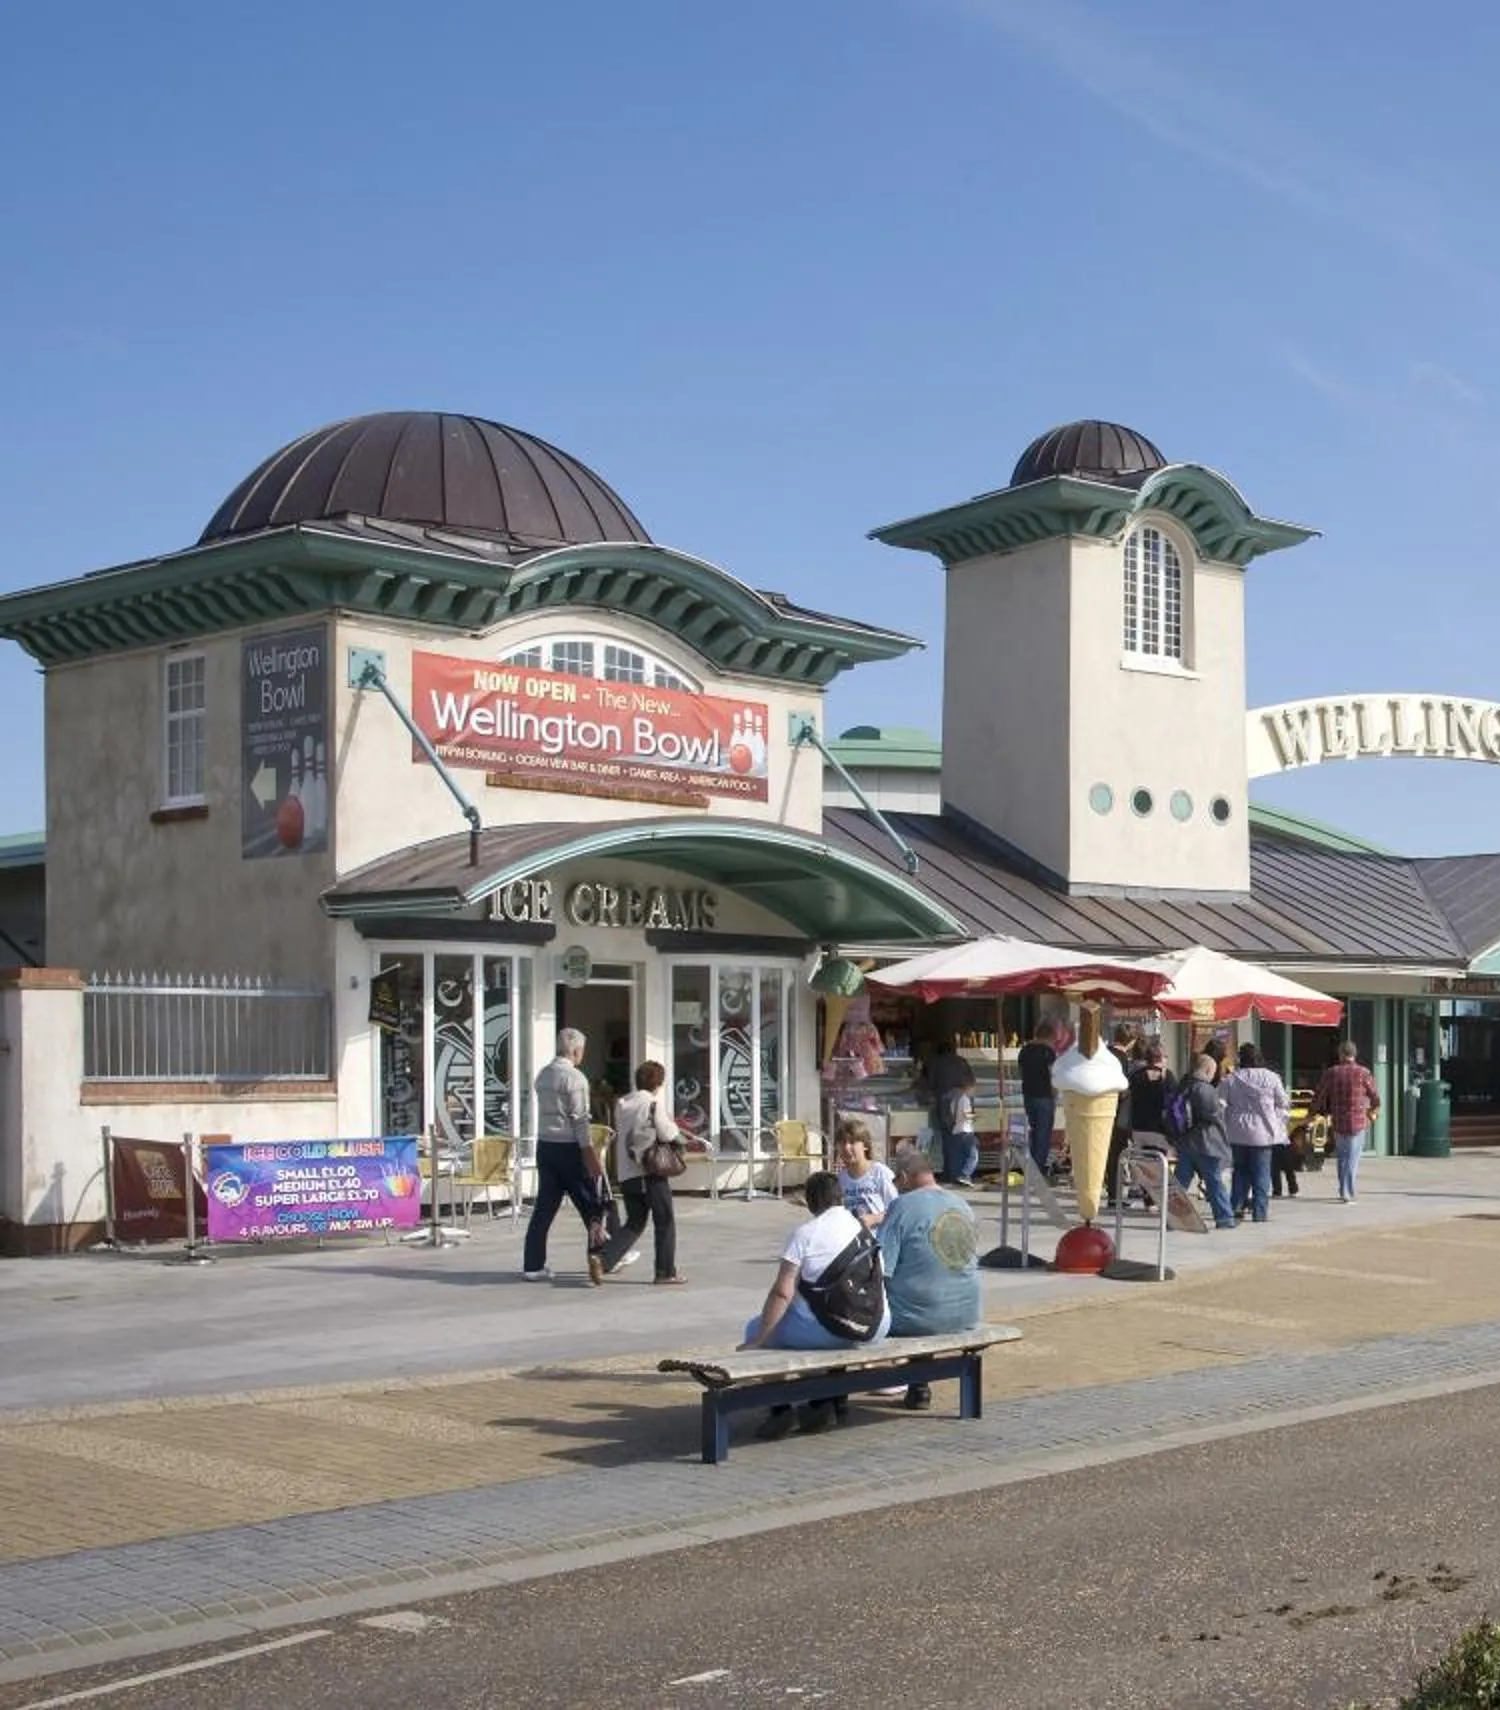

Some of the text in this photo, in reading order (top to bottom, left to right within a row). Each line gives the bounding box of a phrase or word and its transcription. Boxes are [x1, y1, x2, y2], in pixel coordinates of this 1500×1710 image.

[248, 646, 319, 679] Wellington
[261, 673, 305, 713] Bowl
[473, 670, 521, 694] NOW
[525, 677, 577, 703] OPEN
[596, 687, 627, 709] The
[430, 689, 720, 766] Wellington Bowl
[515, 754, 548, 768] OCEAN
[660, 771, 681, 783] AREA
[489, 879, 719, 931] ICE CREAMS
[244, 1141, 385, 1162] ICE COLD SLUSH
[272, 1180, 325, 1193] MEDIUM
[277, 1169, 320, 1181] SMALL
[255, 1193, 300, 1207] SUPER
[303, 1190, 346, 1204] LARGE
[239, 1227, 248, 1237] 4
[251, 1223, 308, 1236] FLAVOURS
[329, 1220, 351, 1231] MIX
[277, 1209, 359, 1223] CHOOSE FROM
